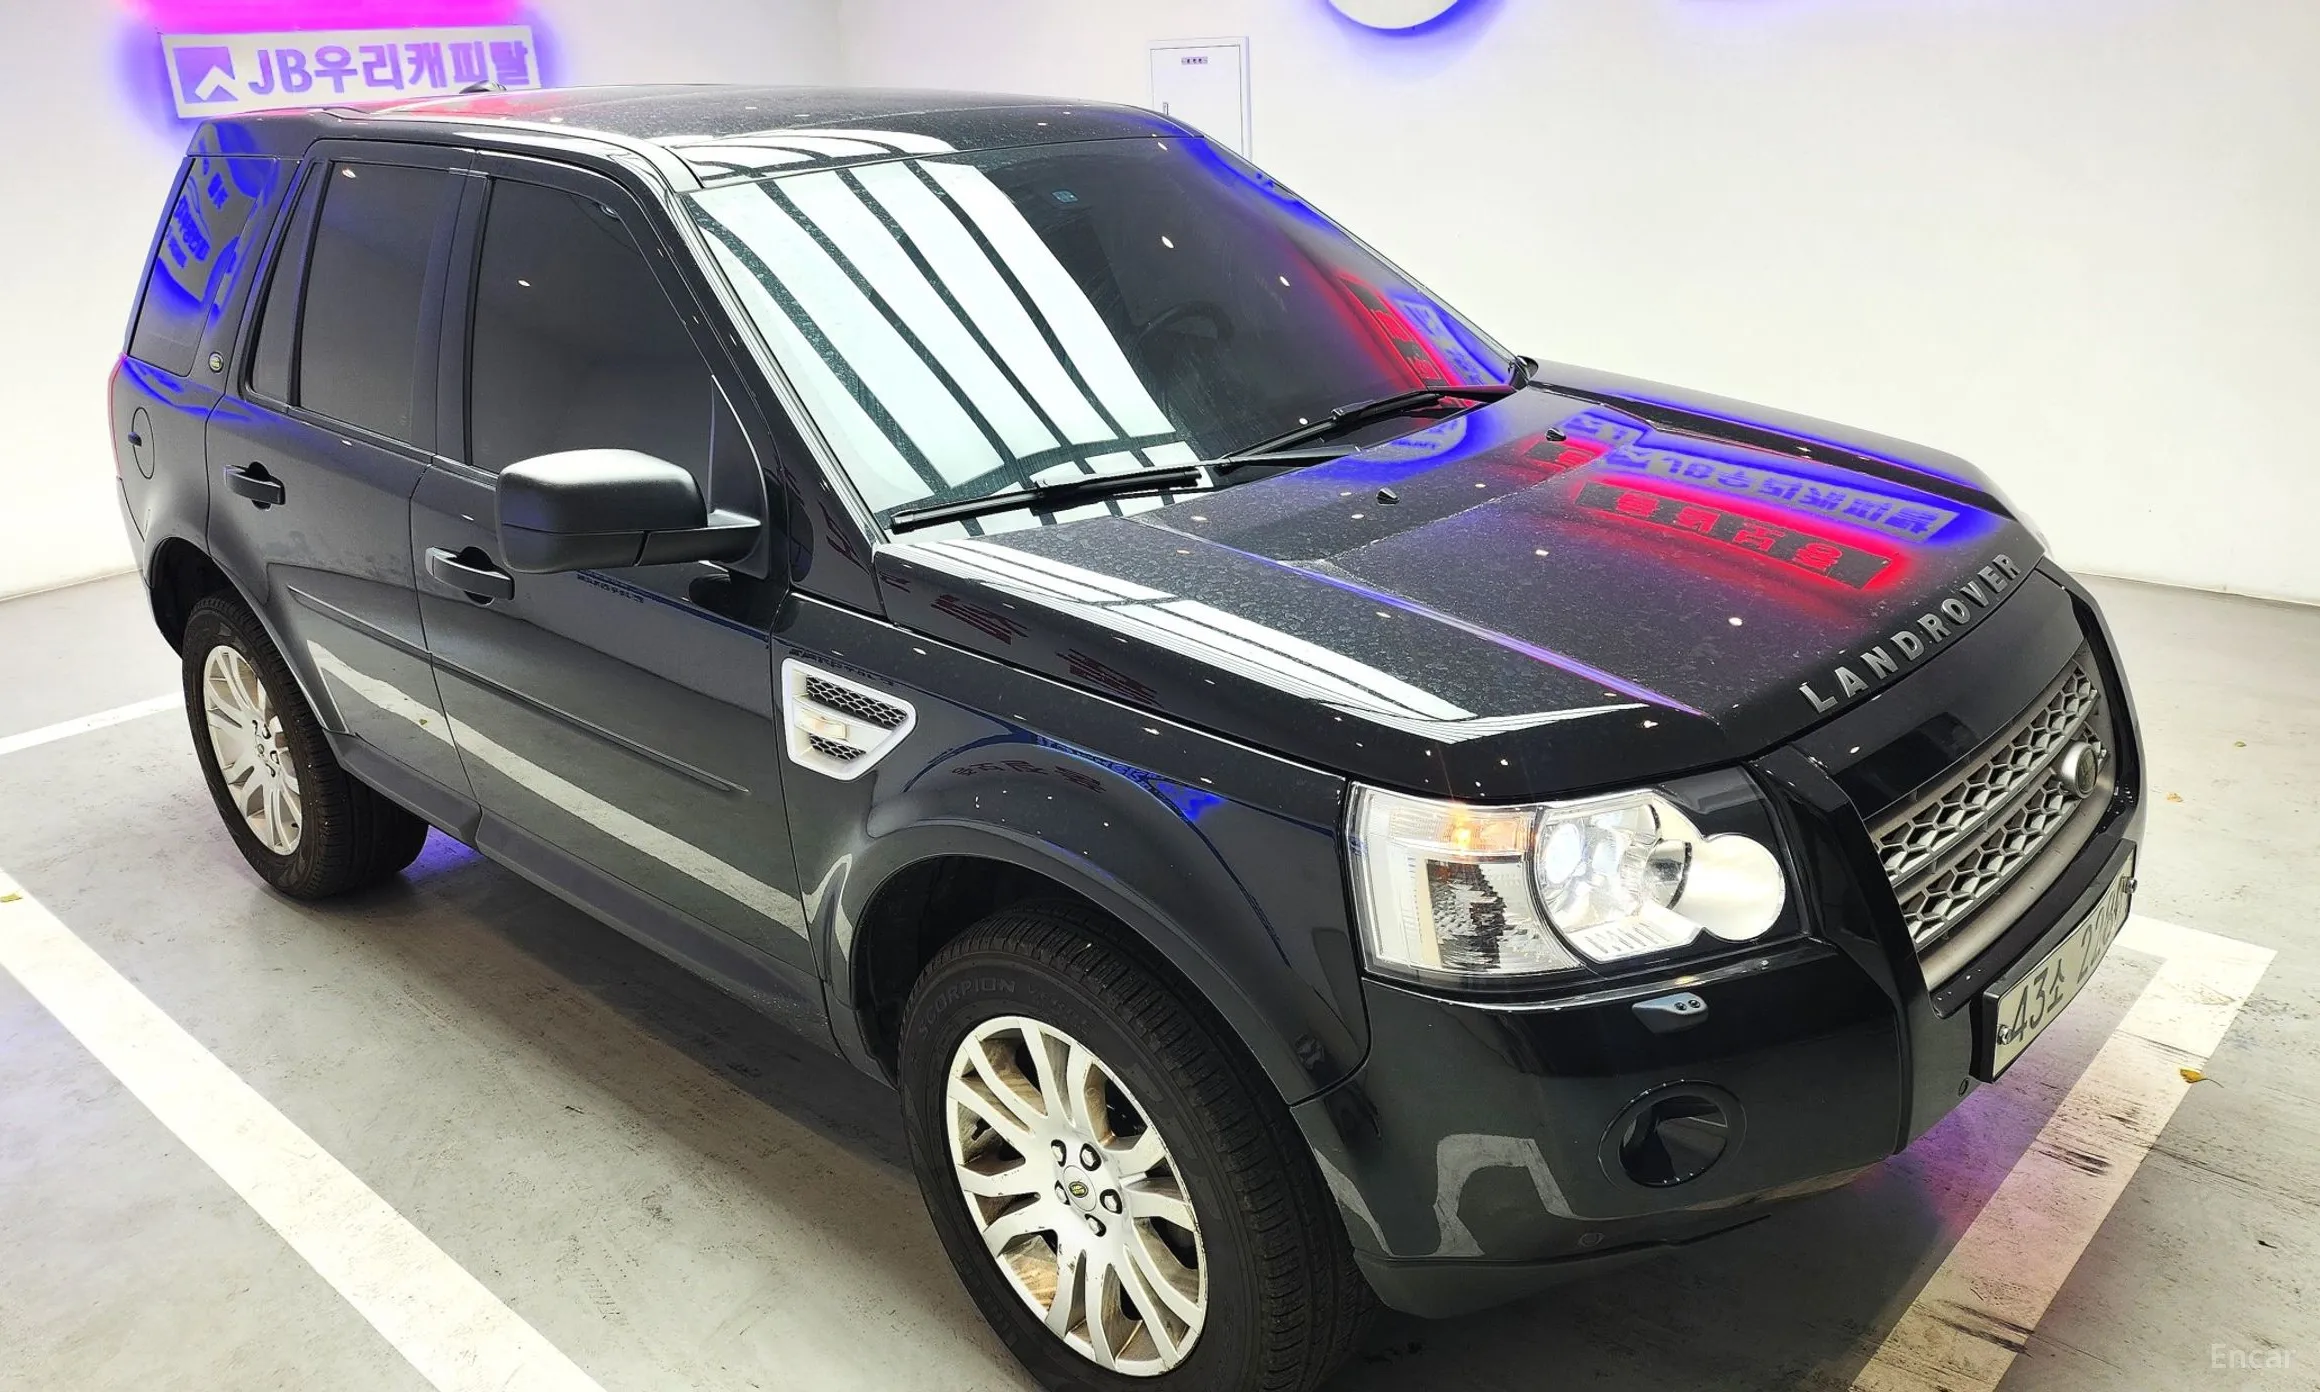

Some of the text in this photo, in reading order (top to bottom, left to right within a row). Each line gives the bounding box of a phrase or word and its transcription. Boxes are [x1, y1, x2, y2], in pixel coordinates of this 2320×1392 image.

[248, 40, 530, 94] JB우리캐피탈
[918, 976, 1016, 1037] SCORPION
[2010, 957, 2065, 1042] 43소
